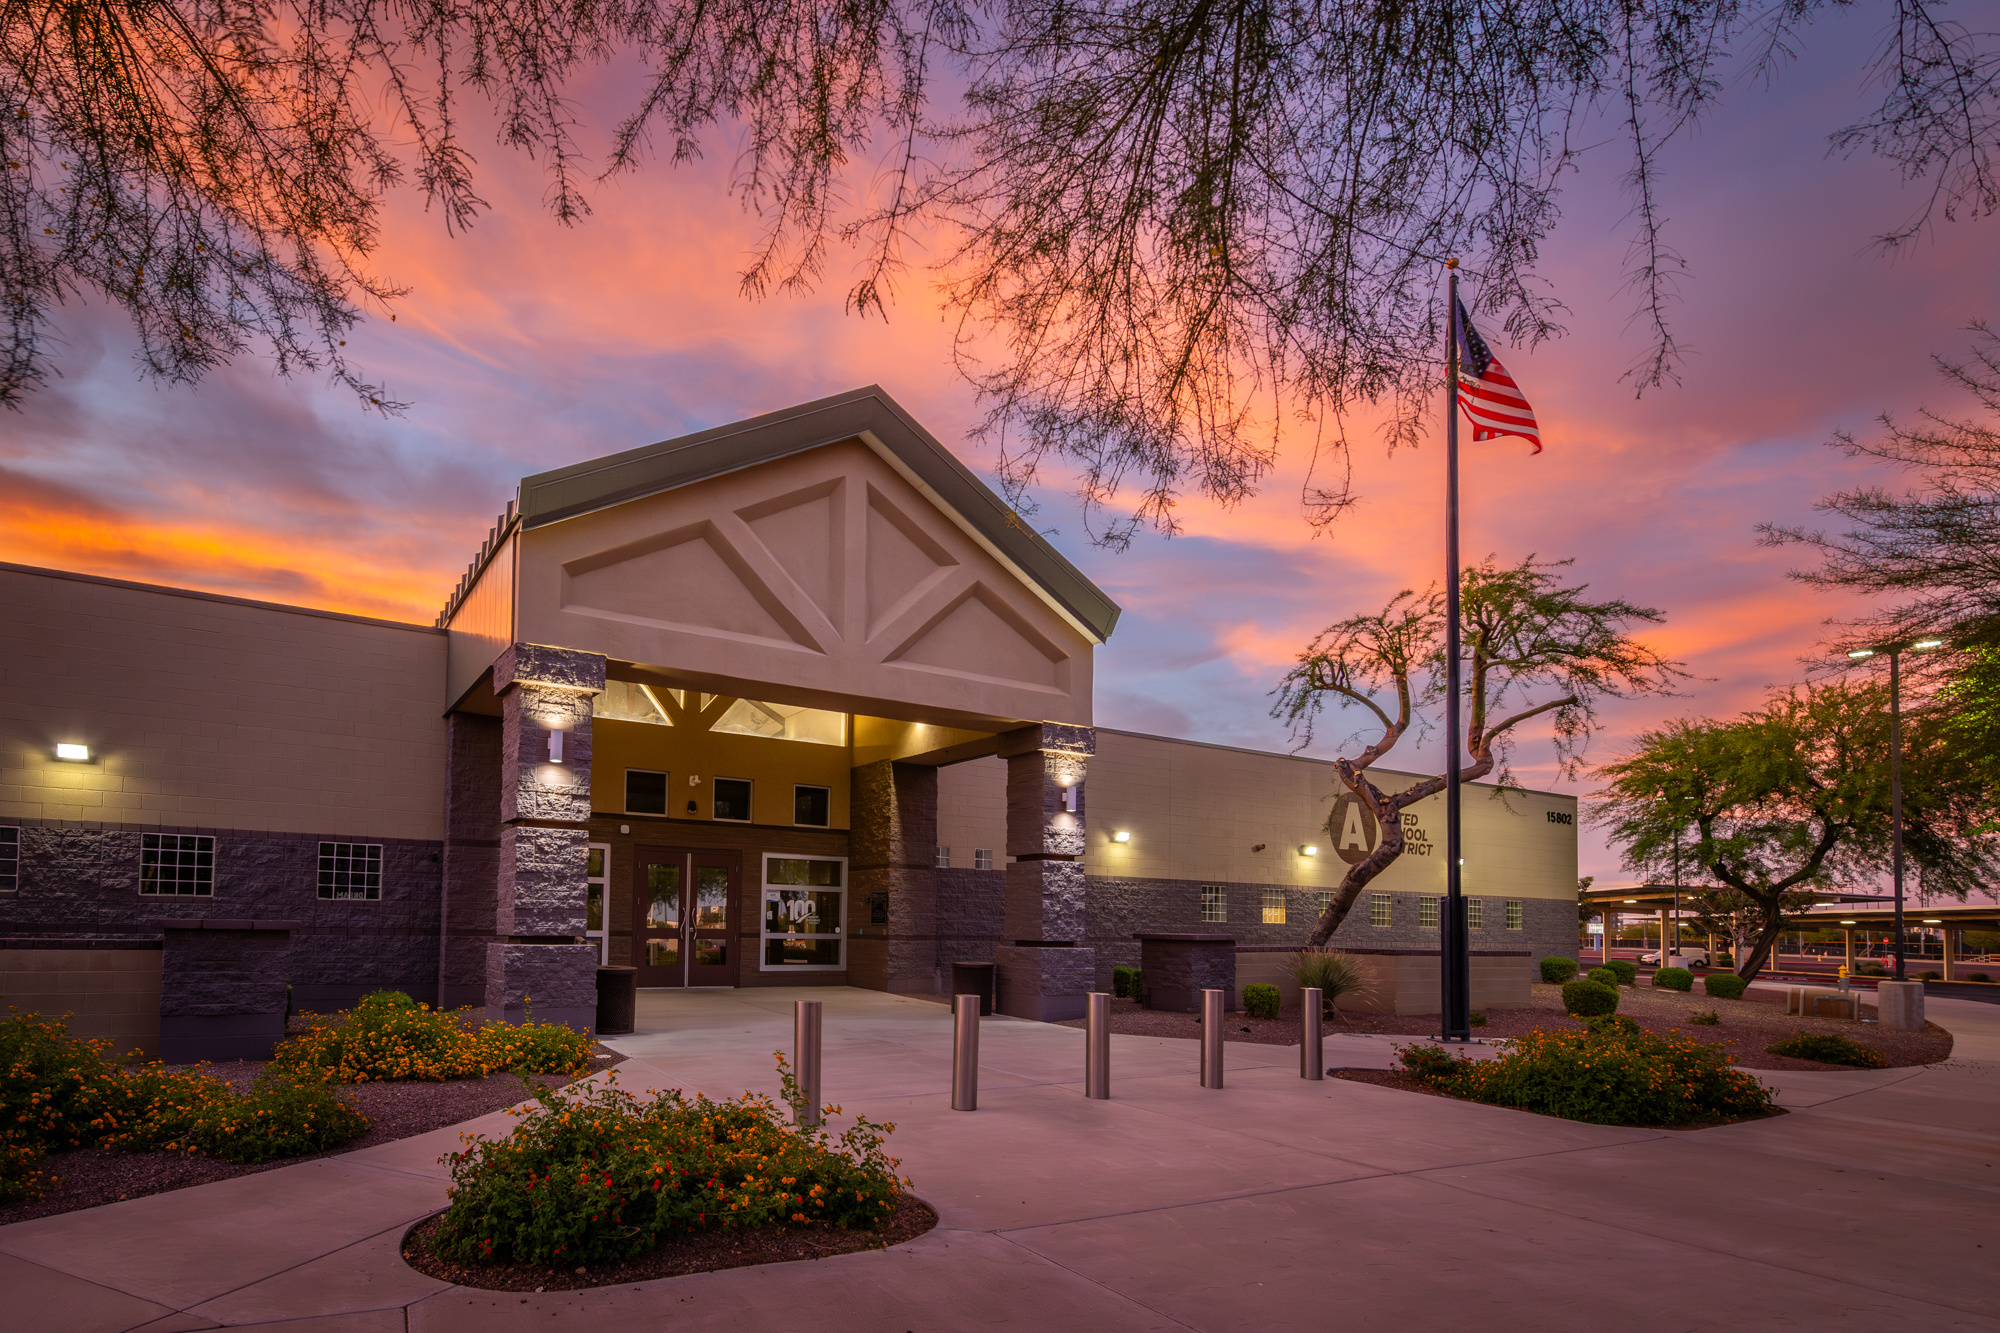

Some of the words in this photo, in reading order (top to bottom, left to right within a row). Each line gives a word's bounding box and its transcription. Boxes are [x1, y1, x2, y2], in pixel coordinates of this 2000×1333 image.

[1546, 811, 1572, 825] 15802
[1339, 802, 1368, 852] A
[1403, 842, 1434, 856] TRICT
[787, 900, 816, 921] 100
